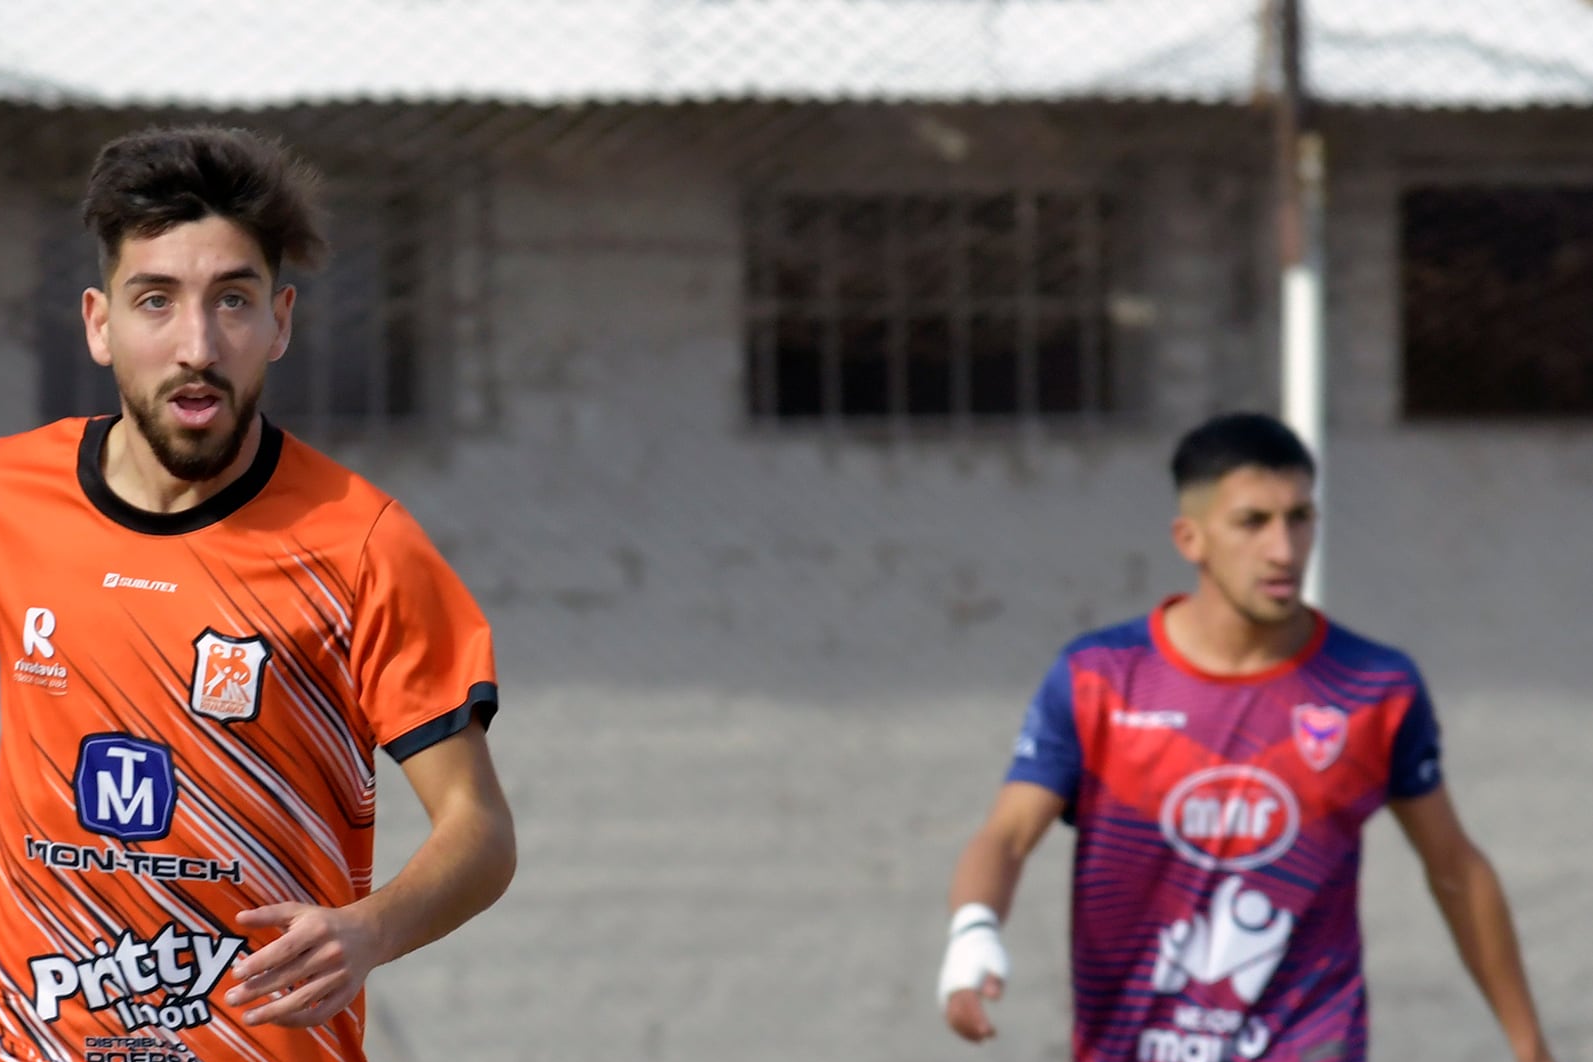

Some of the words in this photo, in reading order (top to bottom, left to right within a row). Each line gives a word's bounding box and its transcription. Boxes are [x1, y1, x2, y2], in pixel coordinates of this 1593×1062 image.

[117, 577, 178, 593] SUBLITEX
[22, 607, 55, 658] R
[24, 834, 245, 883] MON-TECH
